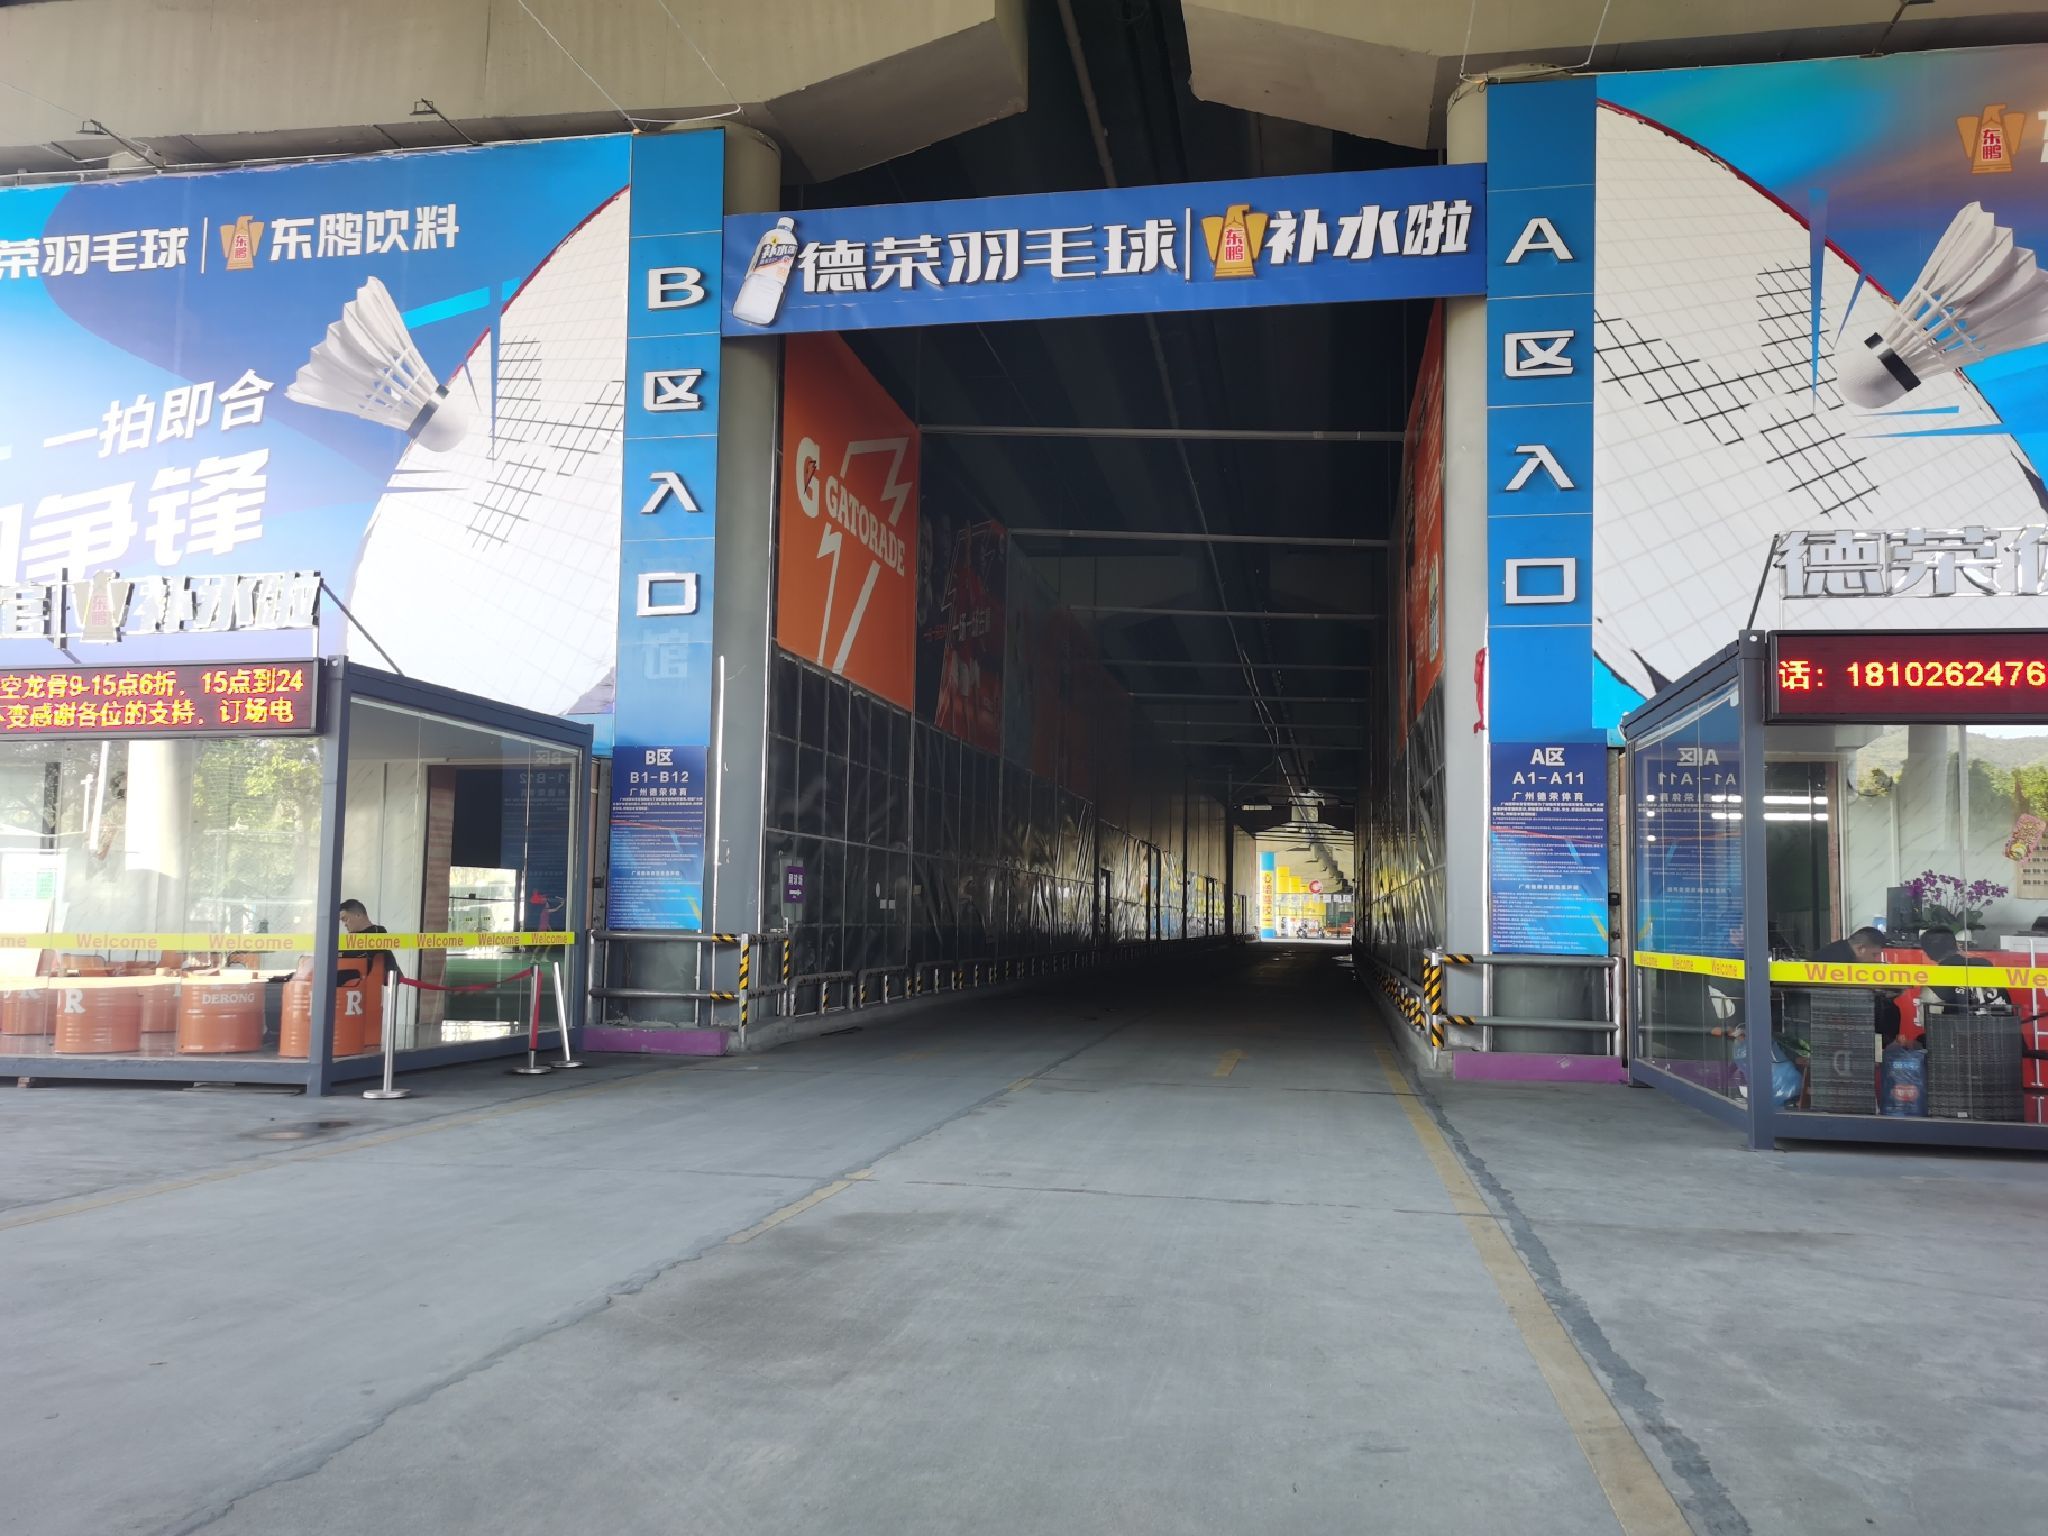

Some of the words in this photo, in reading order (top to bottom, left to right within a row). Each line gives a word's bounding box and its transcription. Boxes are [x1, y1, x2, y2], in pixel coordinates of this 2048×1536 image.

[270, 203, 460, 262] 东鹏饮料
[1265, 200, 1472, 264] 补水啦
[797, 219, 1178, 294] 德荣羽毛球
[43, 369, 275, 458] 一拍即合
[1504, 216, 1576, 605] A区入口
[636, 268, 704, 616] B区入口
[796, 437, 820, 518] G
[0, 448, 269, 585] 争锋
[825, 475, 905, 577] GATORADE
[630, 770, 689, 784] B1-B12
[645, 748, 674, 767] B区
[1530, 747, 1566, 766] A区
[1512, 771, 1584, 785] A1-A11
[76, 933, 158, 948] Welcome
[209, 934, 294, 949] Welcome
[346, 934, 400, 949] Welcome
[417, 934, 464, 947] Welcome
[478, 932, 520, 945] Welcome
[531, 931, 568, 944] Welcome
[1804, 963, 1929, 984] Welcome
[202, 993, 255, 1005] DERONG
[345, 990, 363, 1015] R
